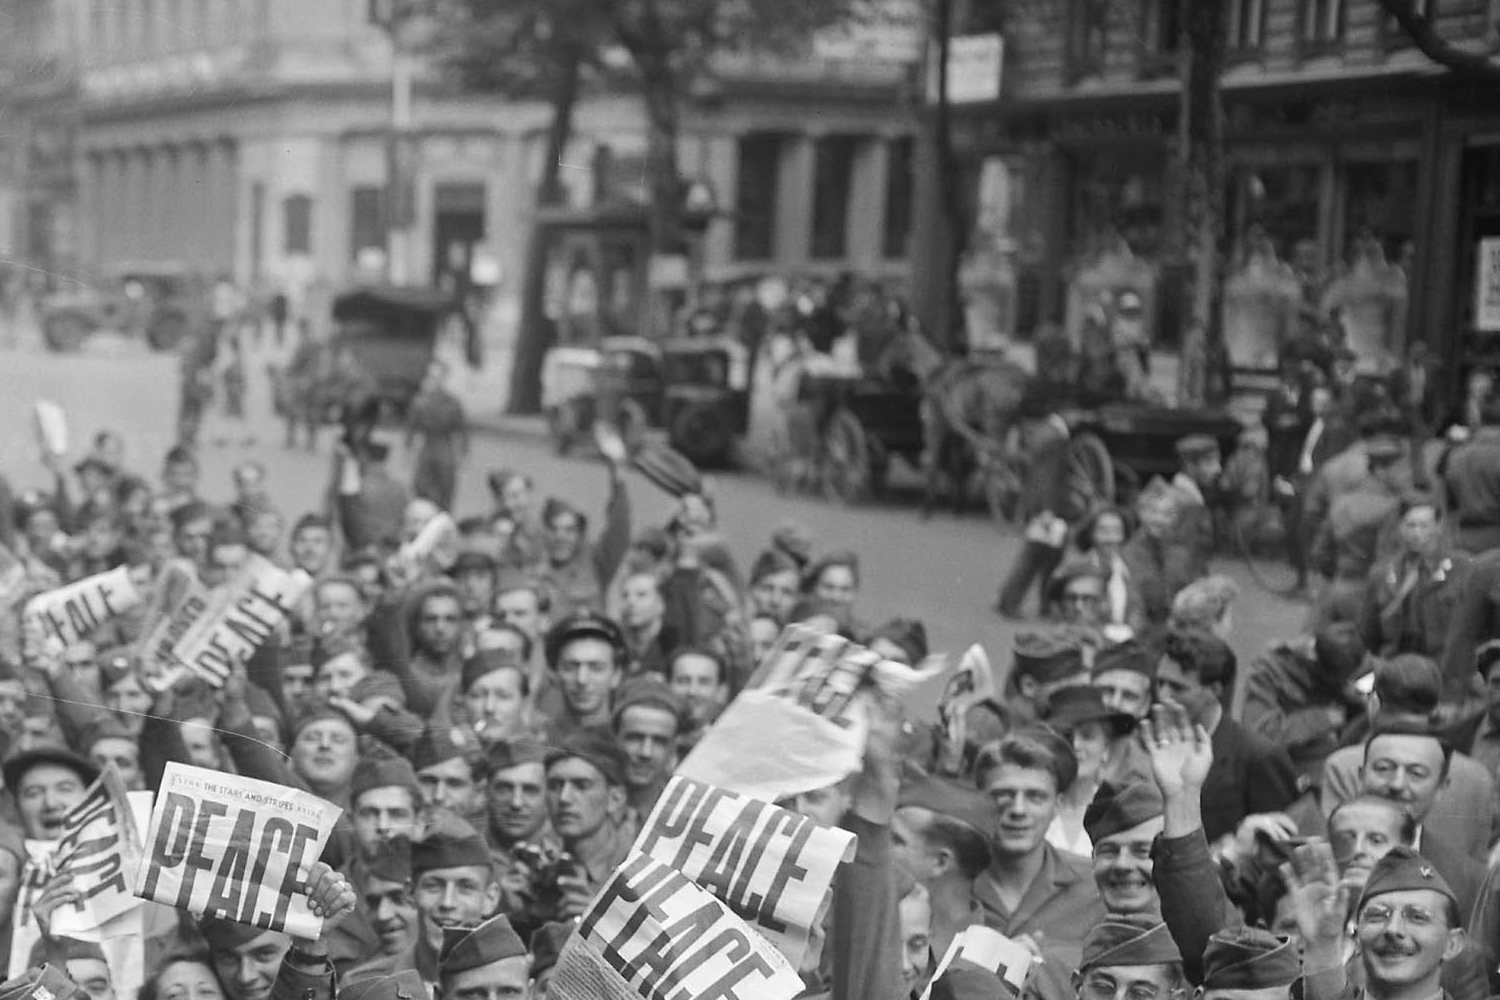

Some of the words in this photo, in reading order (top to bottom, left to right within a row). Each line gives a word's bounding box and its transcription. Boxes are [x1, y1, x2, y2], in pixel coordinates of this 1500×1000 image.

[142, 791, 319, 932] PEACE
[245, 793, 262, 803] AND
[641, 776, 812, 933] PEACE
